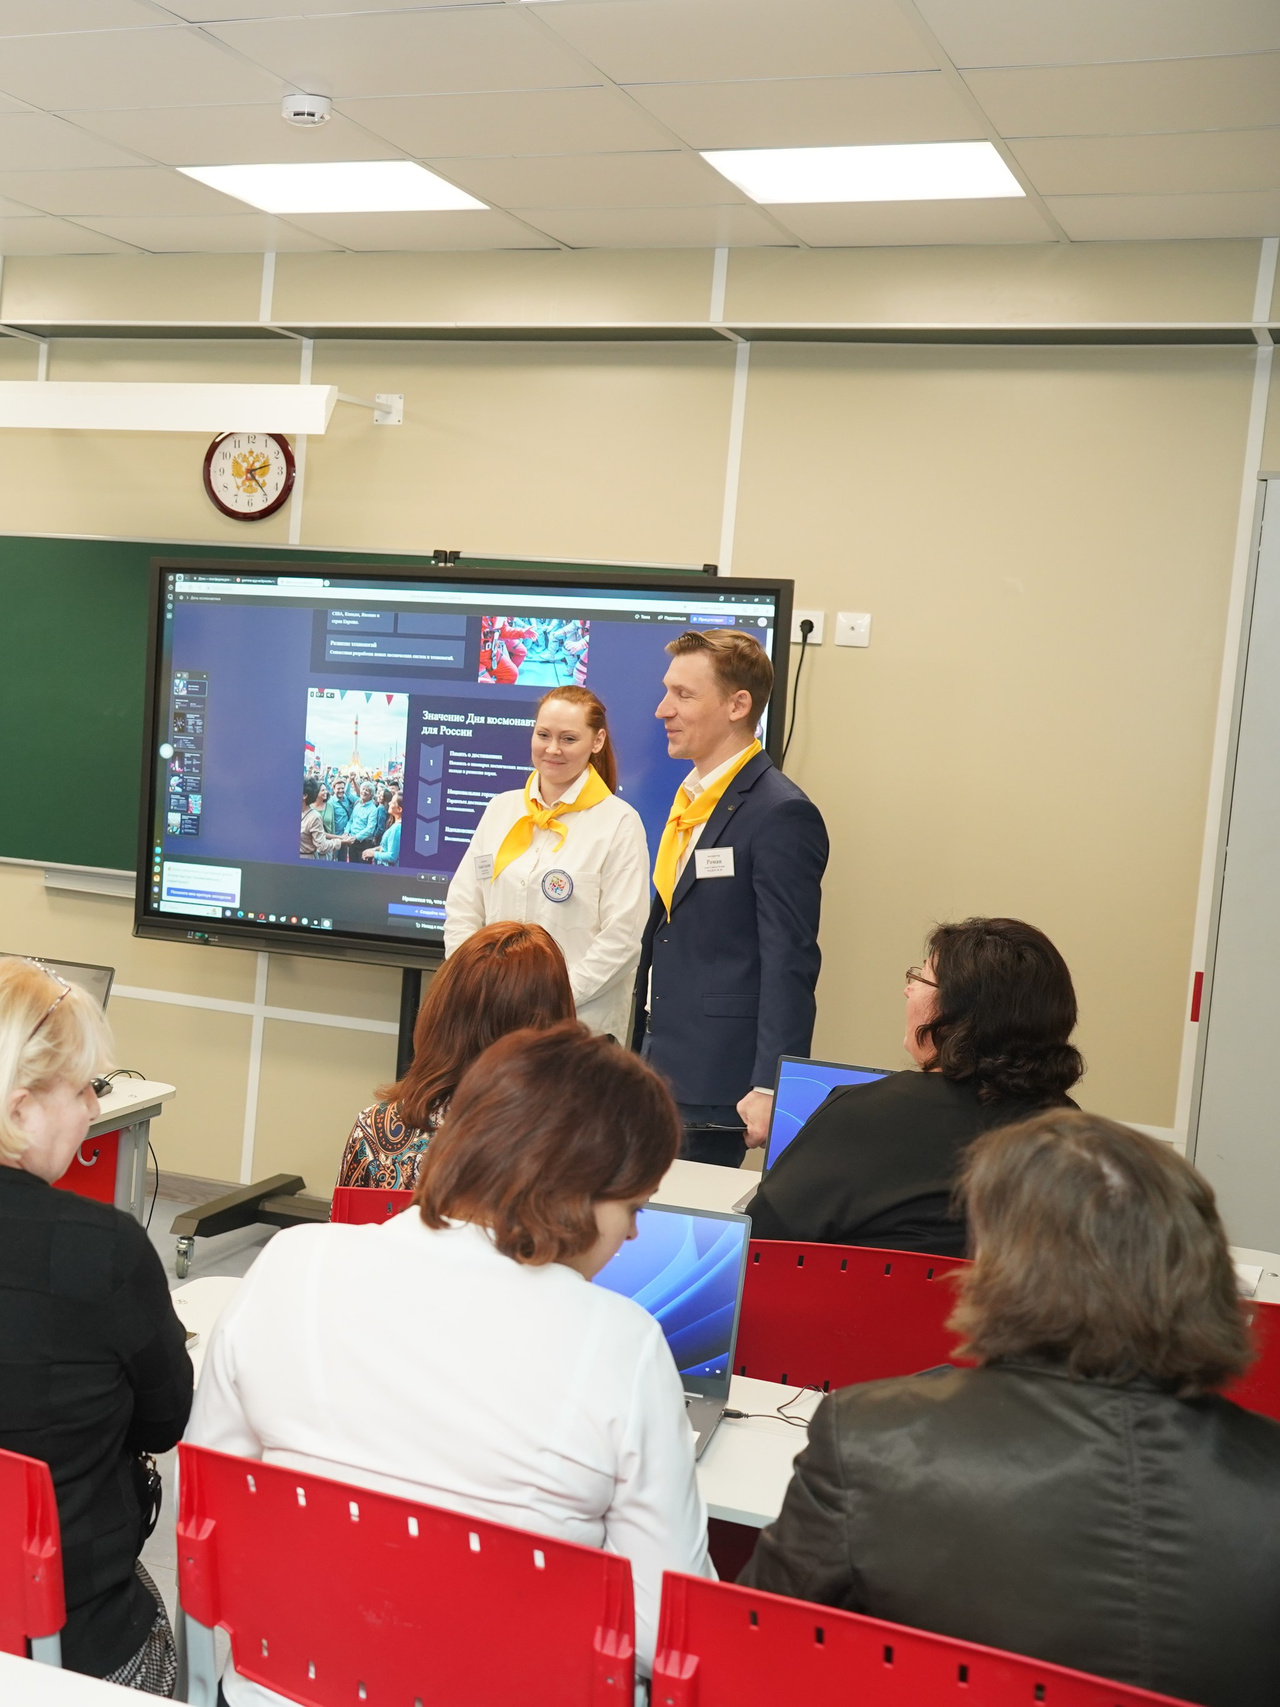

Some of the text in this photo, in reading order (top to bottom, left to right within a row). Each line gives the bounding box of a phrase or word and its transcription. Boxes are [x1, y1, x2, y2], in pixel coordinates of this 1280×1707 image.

[233, 439, 241, 448] 11
[247, 434, 256, 444] 12
[222, 451, 231, 460] 10
[274, 450, 280, 459] 2
[219, 467, 225, 476] 9
[277, 466, 283, 475] 3
[223, 483, 228, 492] 8
[233, 494, 238, 503] 7
[247, 498, 253, 507] 6
[422, 710, 536, 727] Значение Дня космонавт
[421, 726, 472, 736] для России
[424, 834, 430, 842] 3
